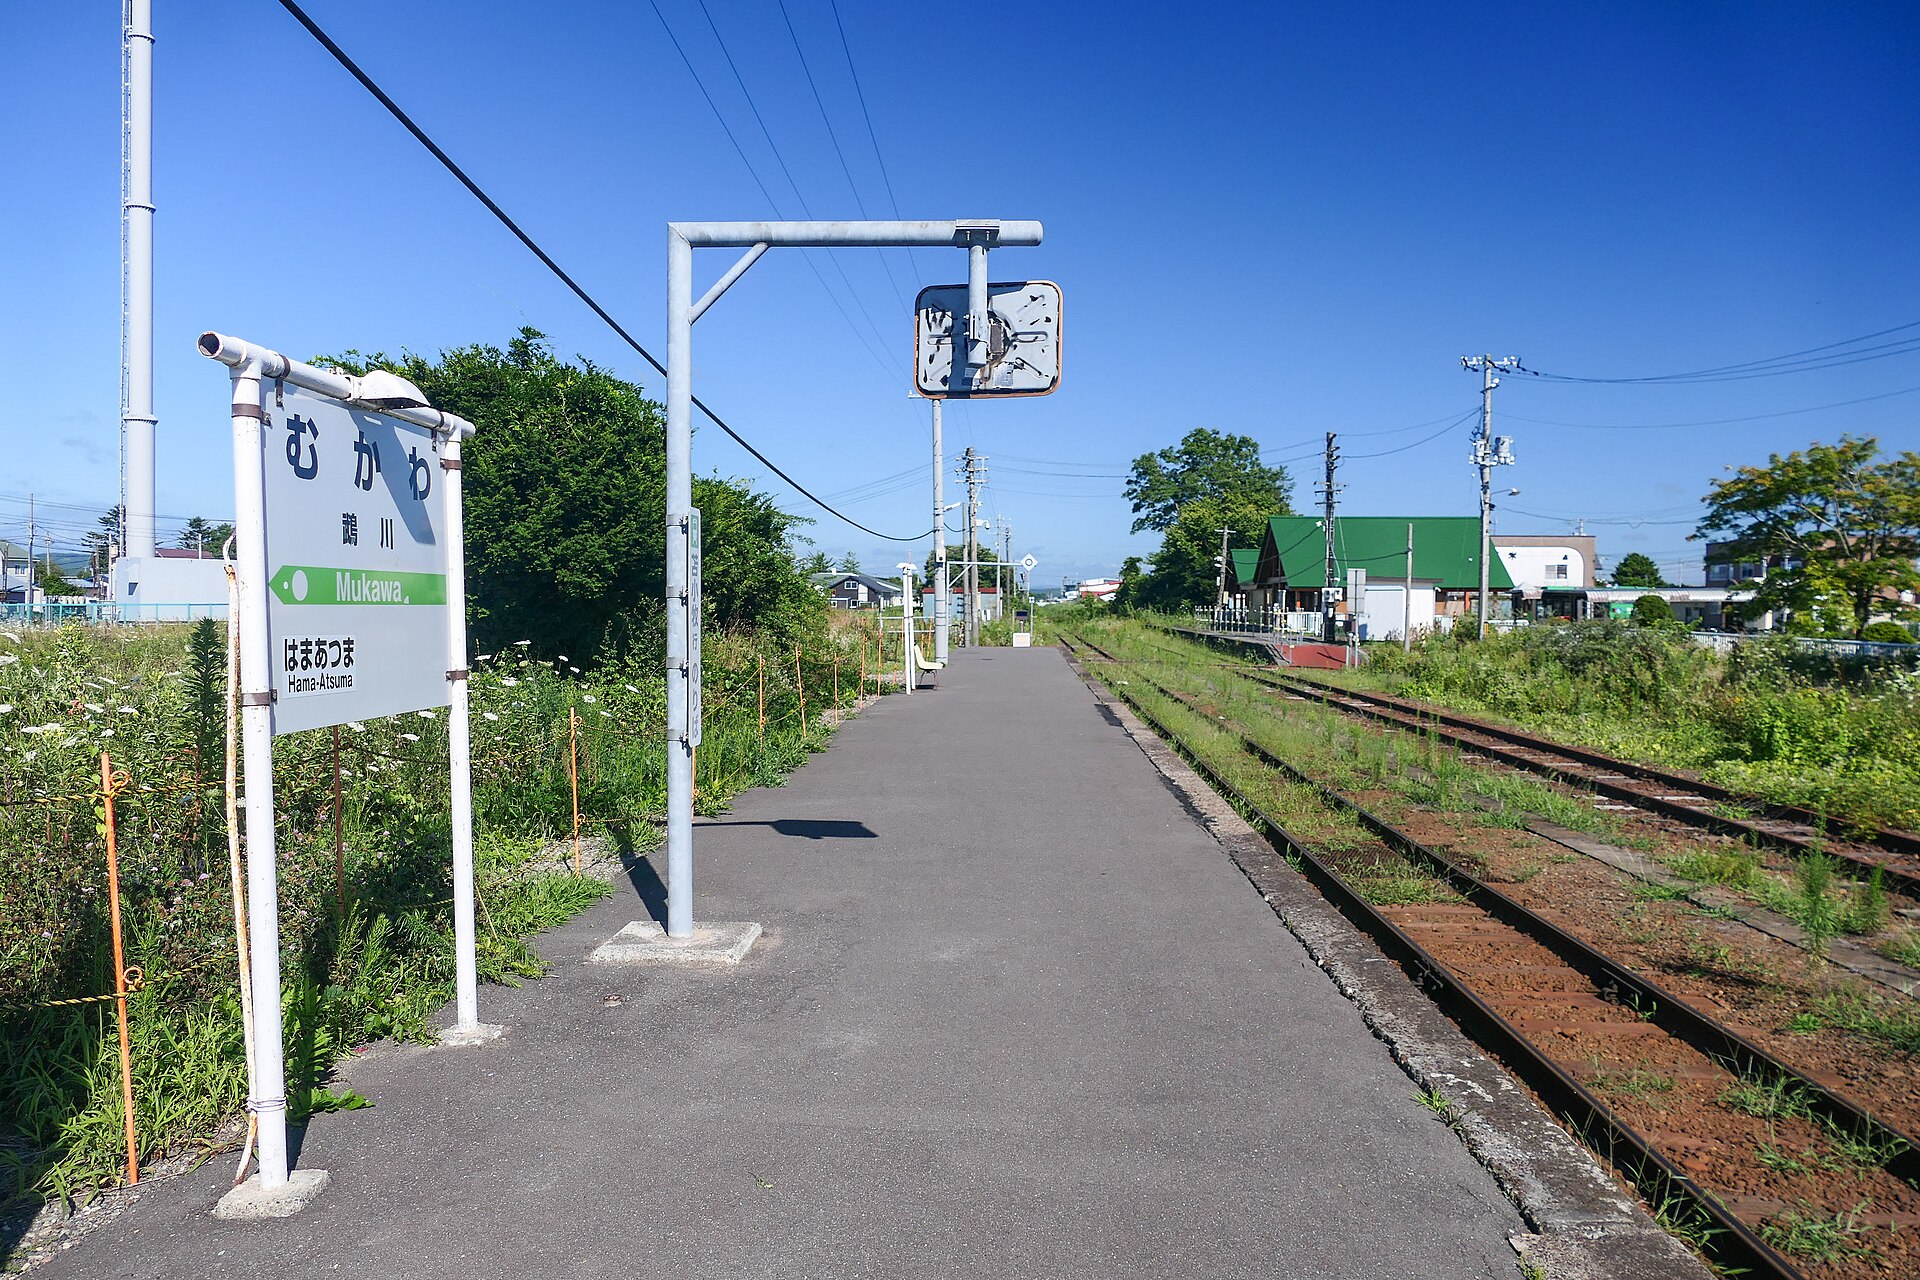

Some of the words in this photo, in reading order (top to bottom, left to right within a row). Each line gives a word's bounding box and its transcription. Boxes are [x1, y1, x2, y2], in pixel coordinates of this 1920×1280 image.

[286, 413, 431, 501] むかわ
[342, 512, 394, 550] 鵡川
[336, 571, 402, 602] Mukawa
[284, 637, 355, 672] はまあつま
[288, 673, 353, 693] Hama-Atsuma
